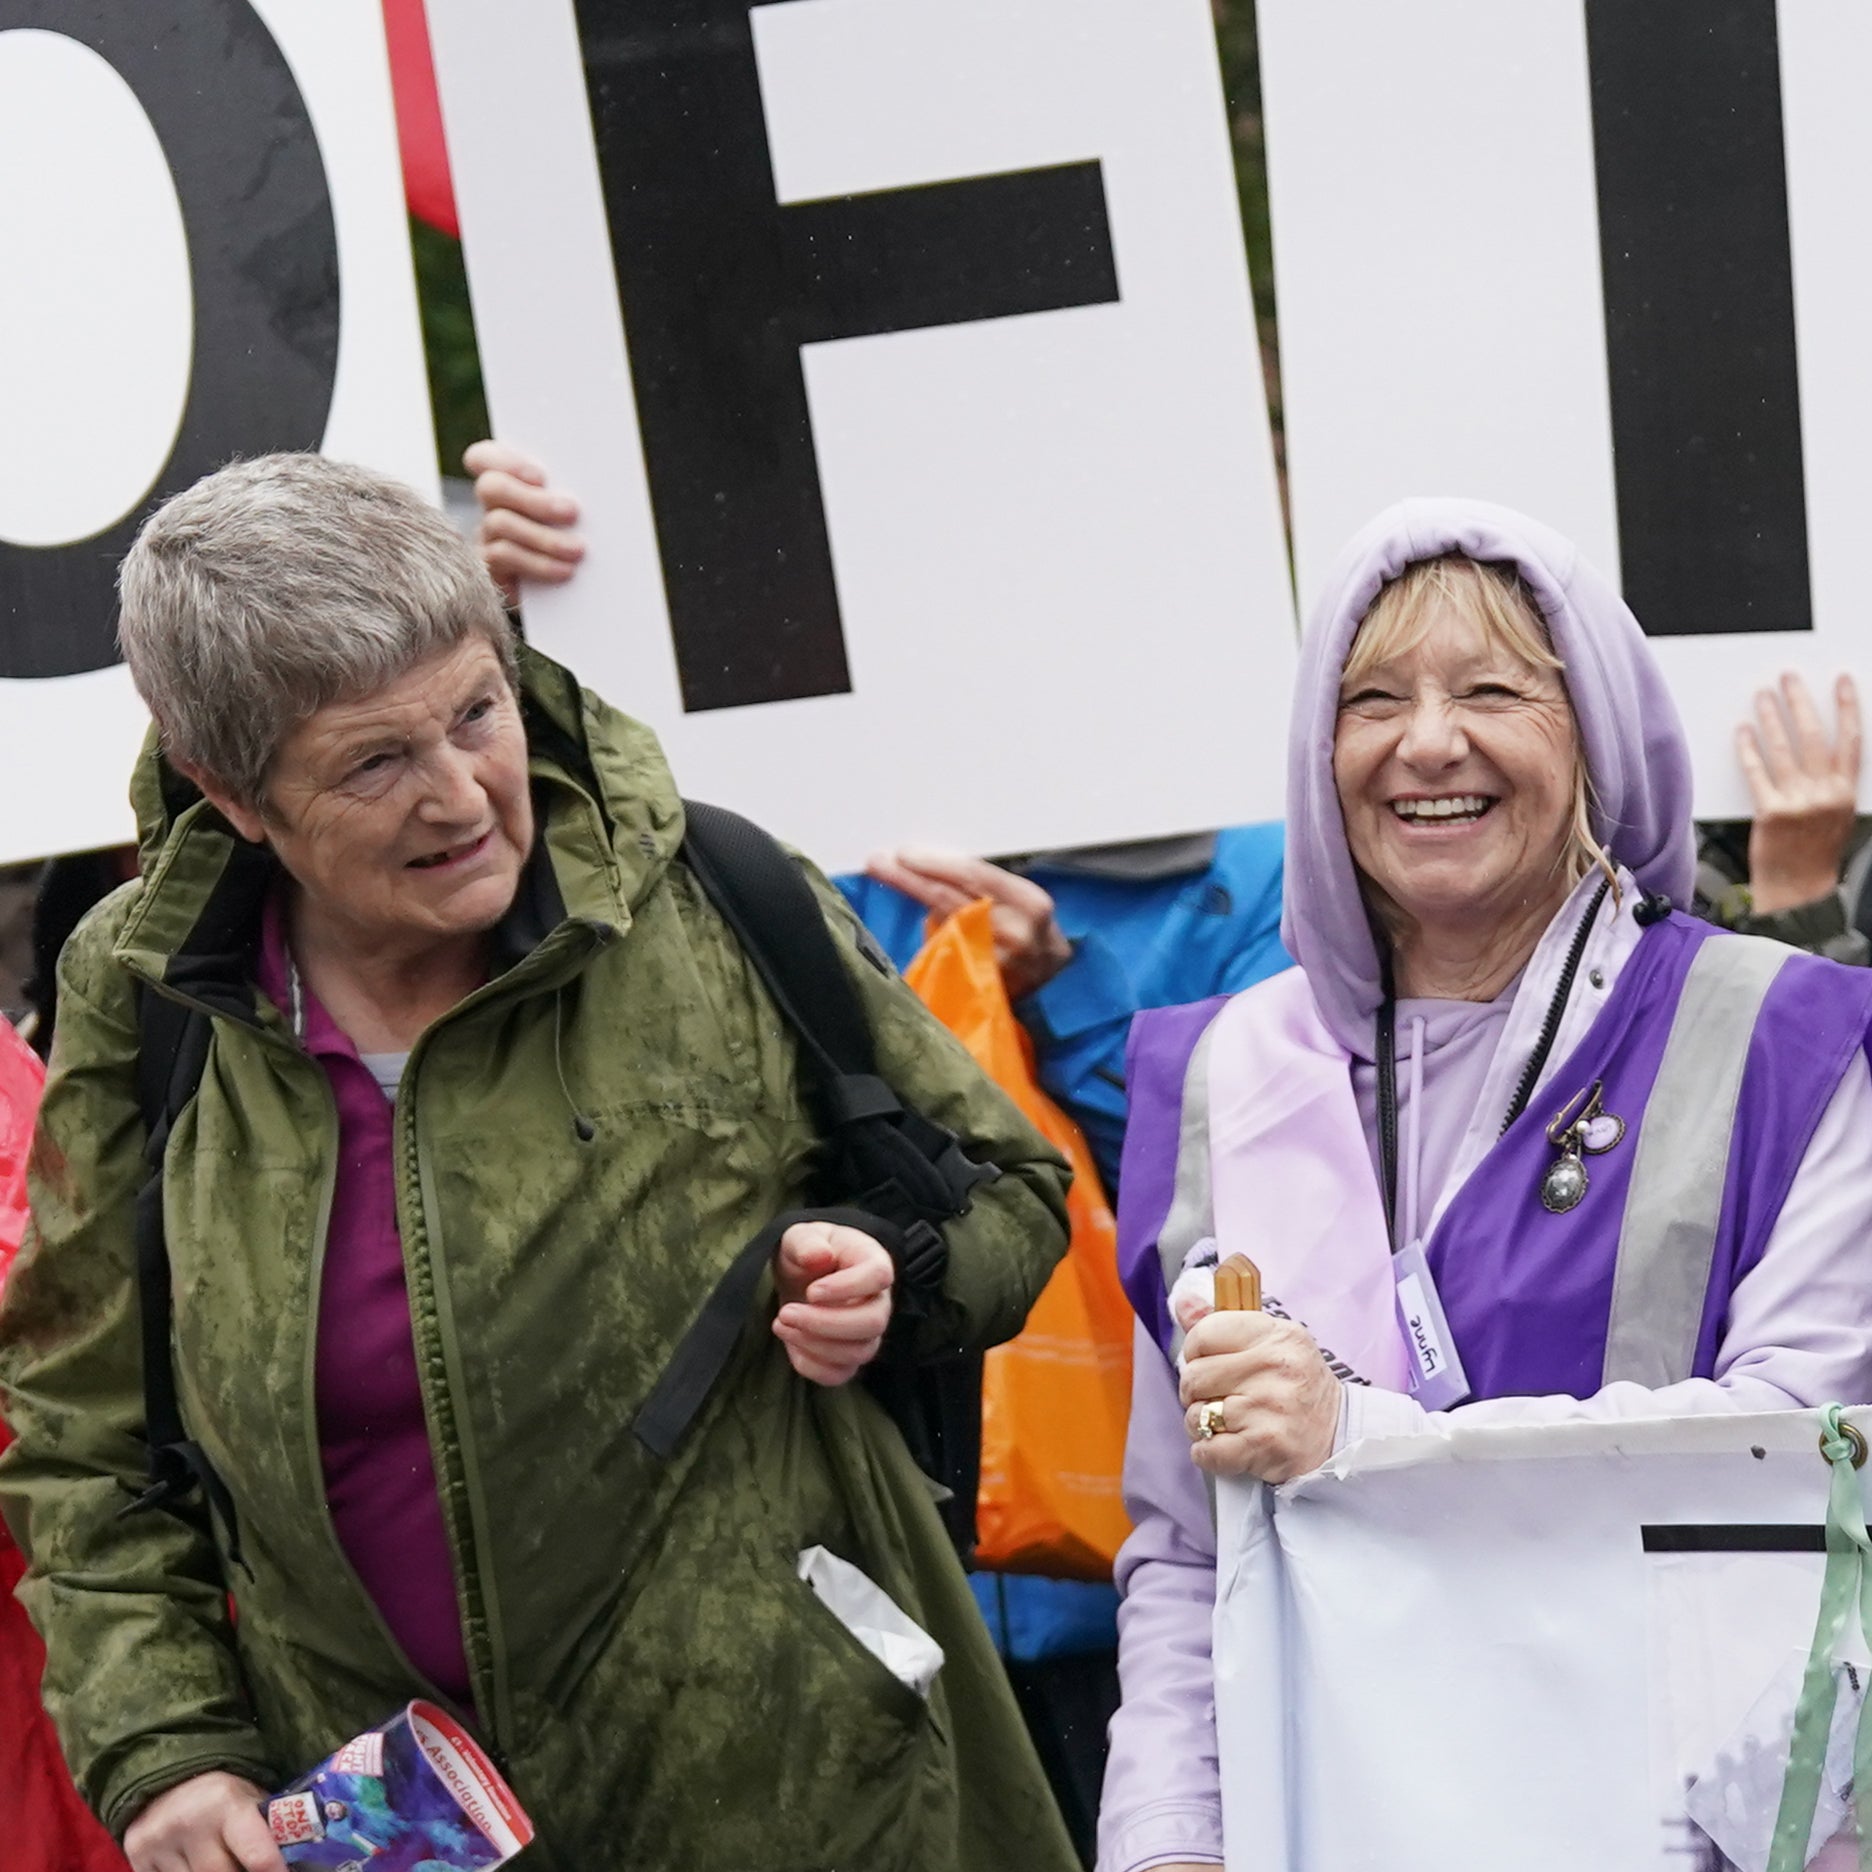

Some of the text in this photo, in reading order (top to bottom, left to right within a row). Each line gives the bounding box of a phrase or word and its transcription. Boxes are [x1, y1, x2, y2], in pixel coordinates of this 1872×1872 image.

[574, 0, 1122, 713] F
[1409, 1314, 1439, 1374] Lynne
[294, 1799, 313, 1833] ONE
[427, 1744, 492, 1836] Association
